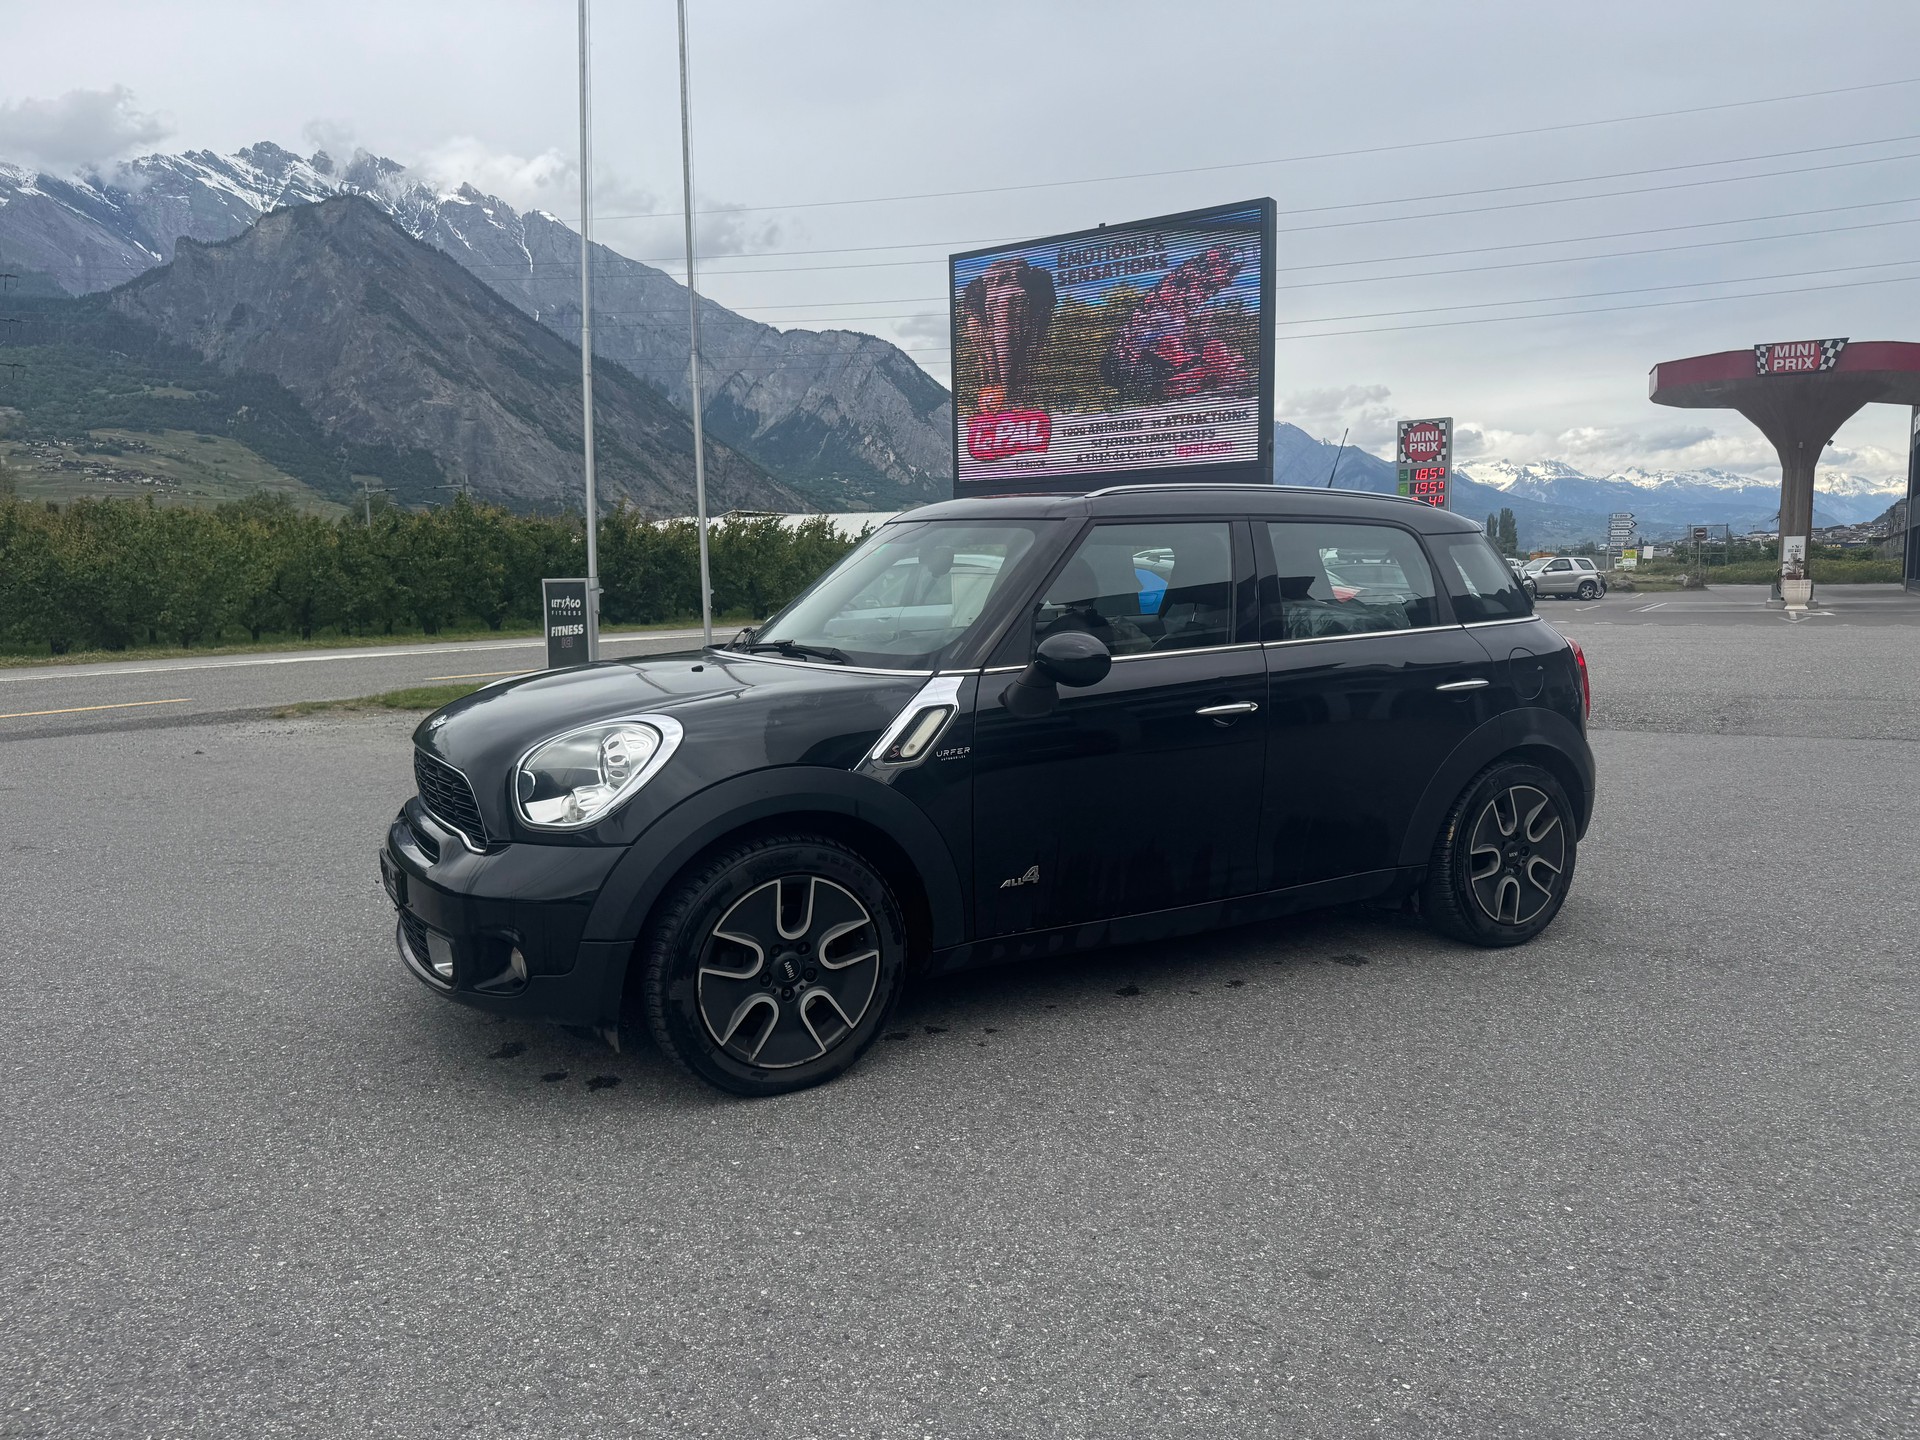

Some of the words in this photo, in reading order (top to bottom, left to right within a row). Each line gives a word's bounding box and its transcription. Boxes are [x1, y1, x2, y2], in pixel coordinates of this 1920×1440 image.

[1057, 254, 1168, 286] SENSATIONS
[1774, 343, 1815, 358] MINI
[1773, 356, 1815, 371] PRIX
[1409, 430, 1439, 442] MINI
[1409, 442, 1438, 453] PRIX
[570, 598, 581, 608] GO
[551, 624, 584, 637] FITNESS
[936, 746, 971, 758] URFER
